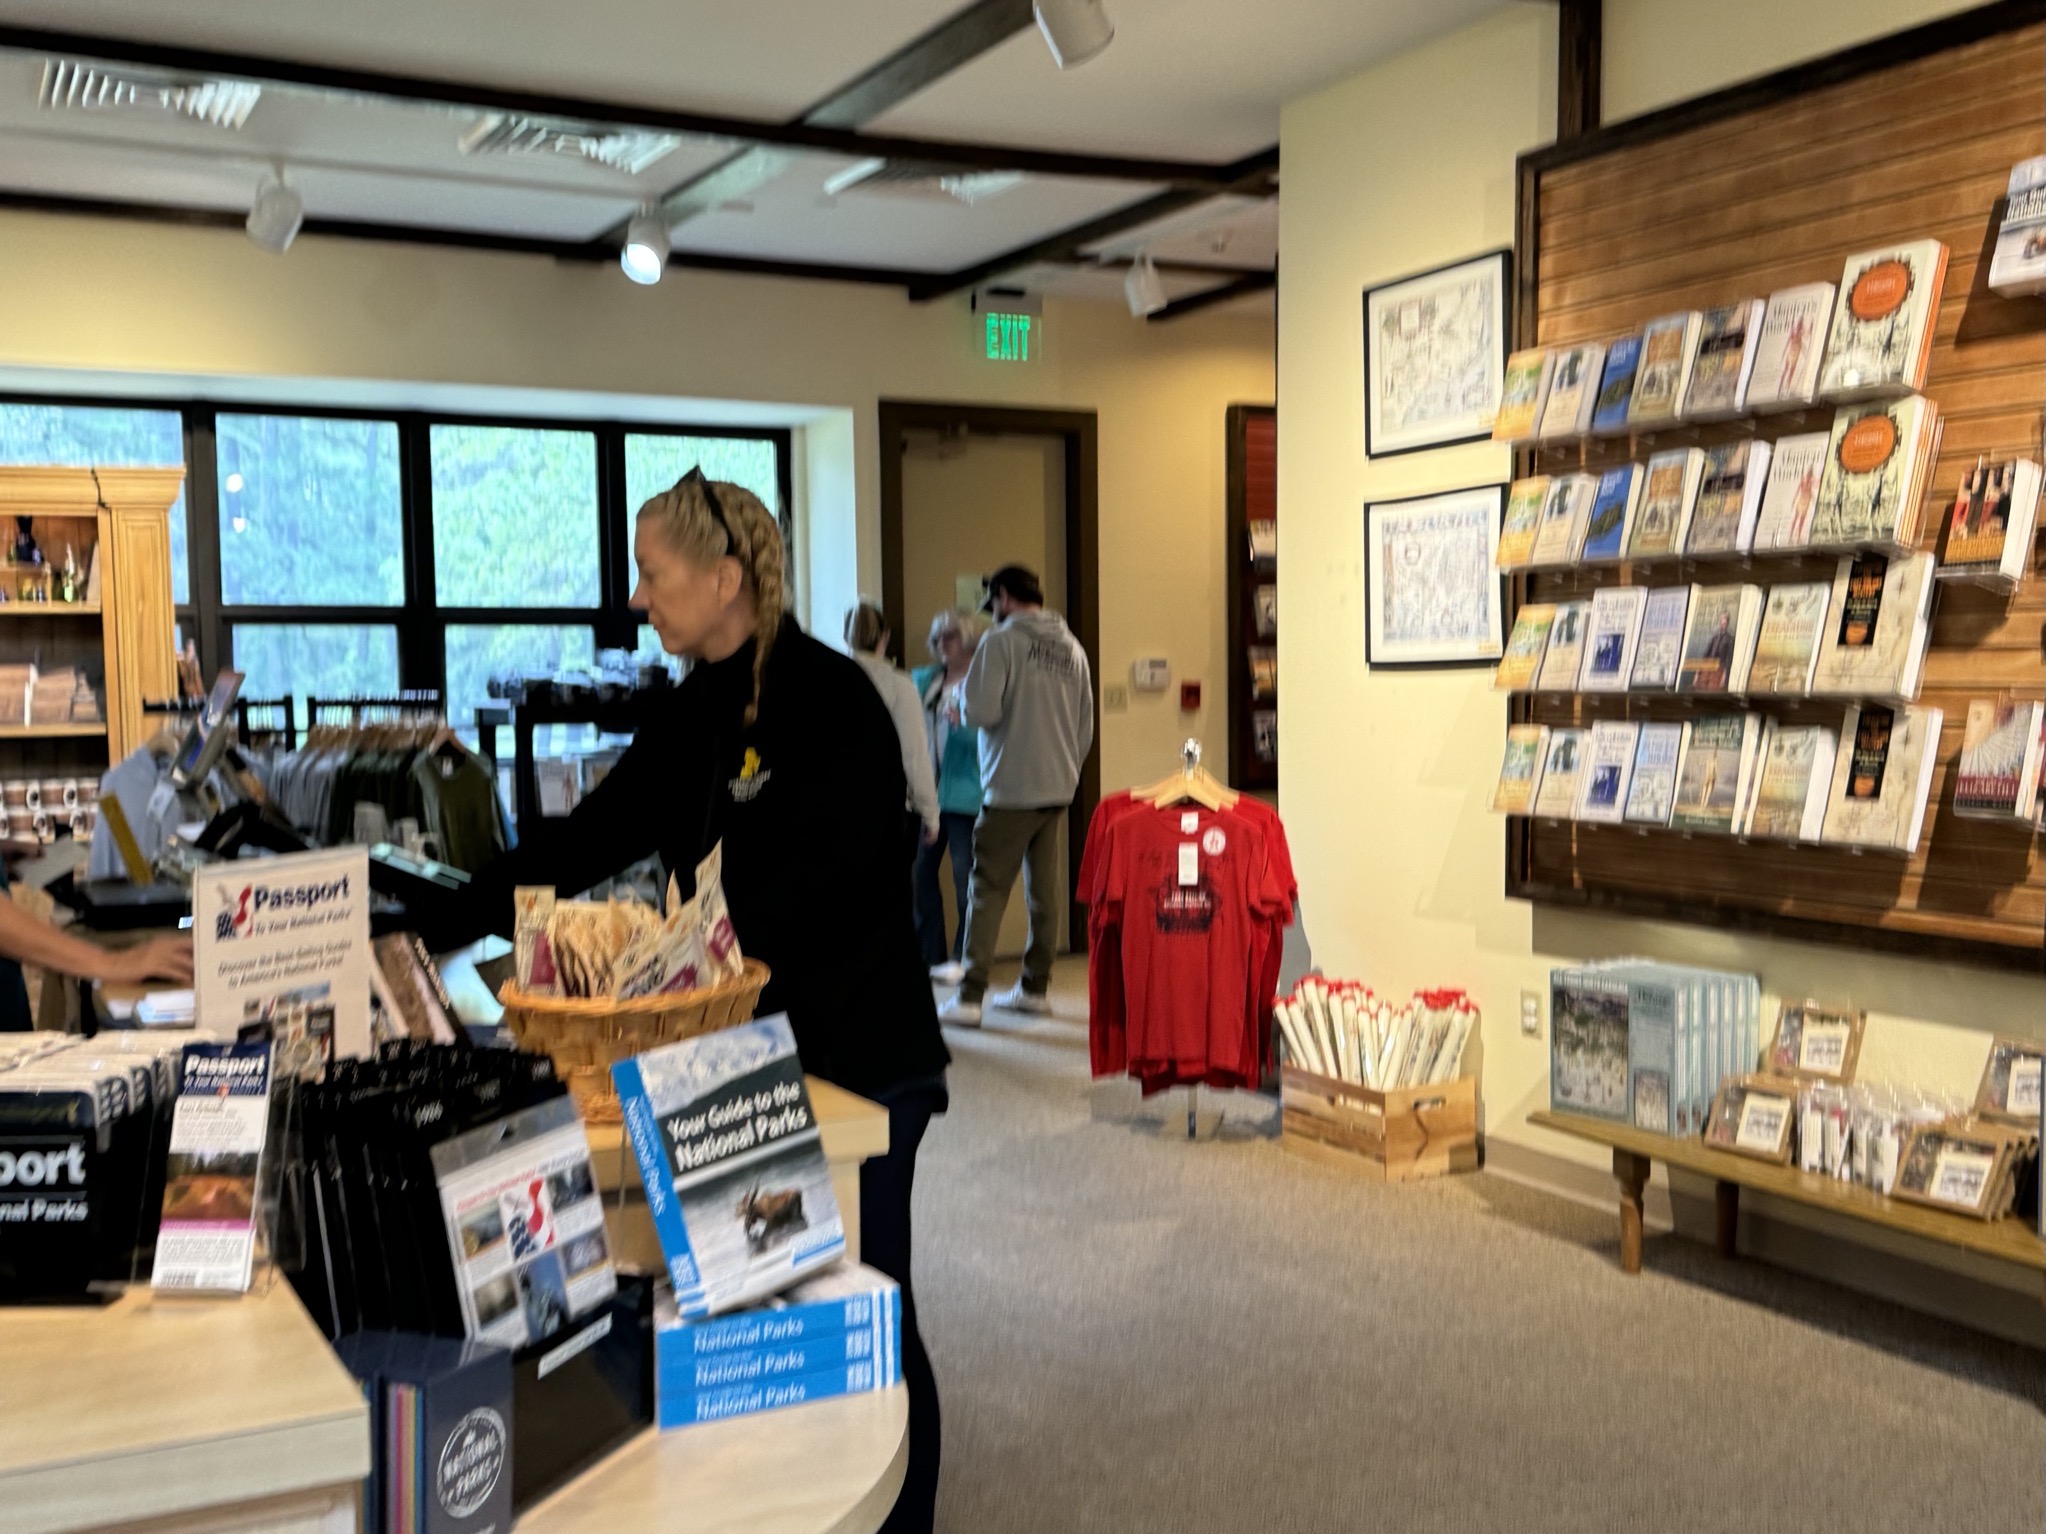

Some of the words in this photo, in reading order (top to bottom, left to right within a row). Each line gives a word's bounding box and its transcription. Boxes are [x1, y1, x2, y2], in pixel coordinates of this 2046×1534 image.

[986, 312, 1031, 361] EXIT
[254, 872, 351, 912] Passport
[185, 1054, 266, 1078] Passport
[667, 1113, 706, 1143] Your
[708, 1095, 754, 1129] Guide
[754, 1090, 772, 1113] to
[773, 1081, 800, 1107] the
[675, 1119, 755, 1172] National
[755, 1105, 807, 1142] Parks
[31, 1198, 89, 1222] Parks
[694, 1322, 759, 1354] National
[763, 1316, 804, 1341] Parks
[695, 1355, 761, 1387] National
[765, 1349, 805, 1374] Parks
[696, 1388, 762, 1421] National
[766, 1382, 806, 1406] Parks
